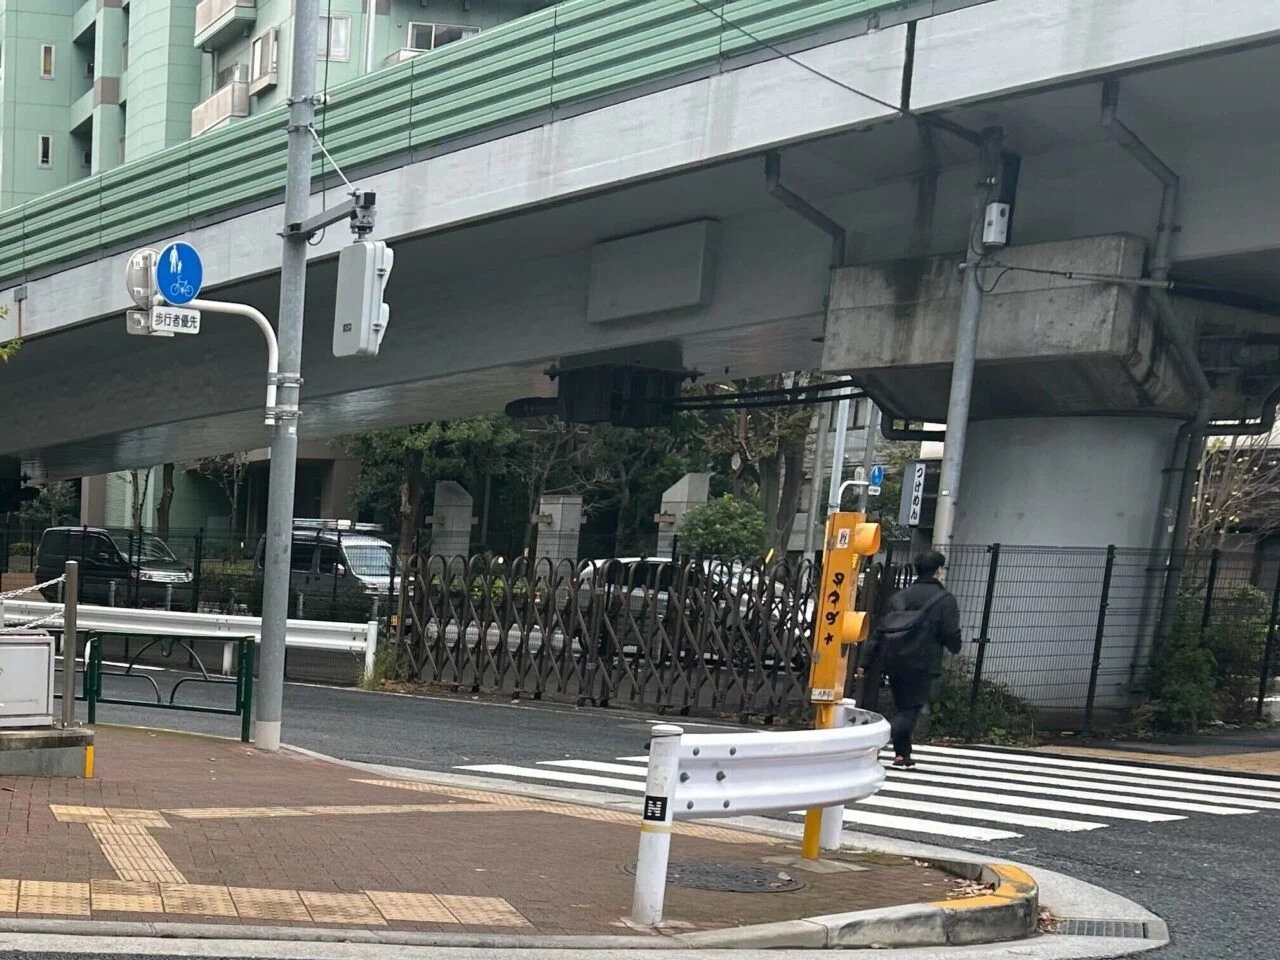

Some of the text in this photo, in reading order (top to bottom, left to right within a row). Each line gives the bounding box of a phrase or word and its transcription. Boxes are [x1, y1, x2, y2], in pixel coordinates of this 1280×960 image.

[155, 313, 198, 329] 歩行者優先
[910, 467, 924, 520] つけめん
